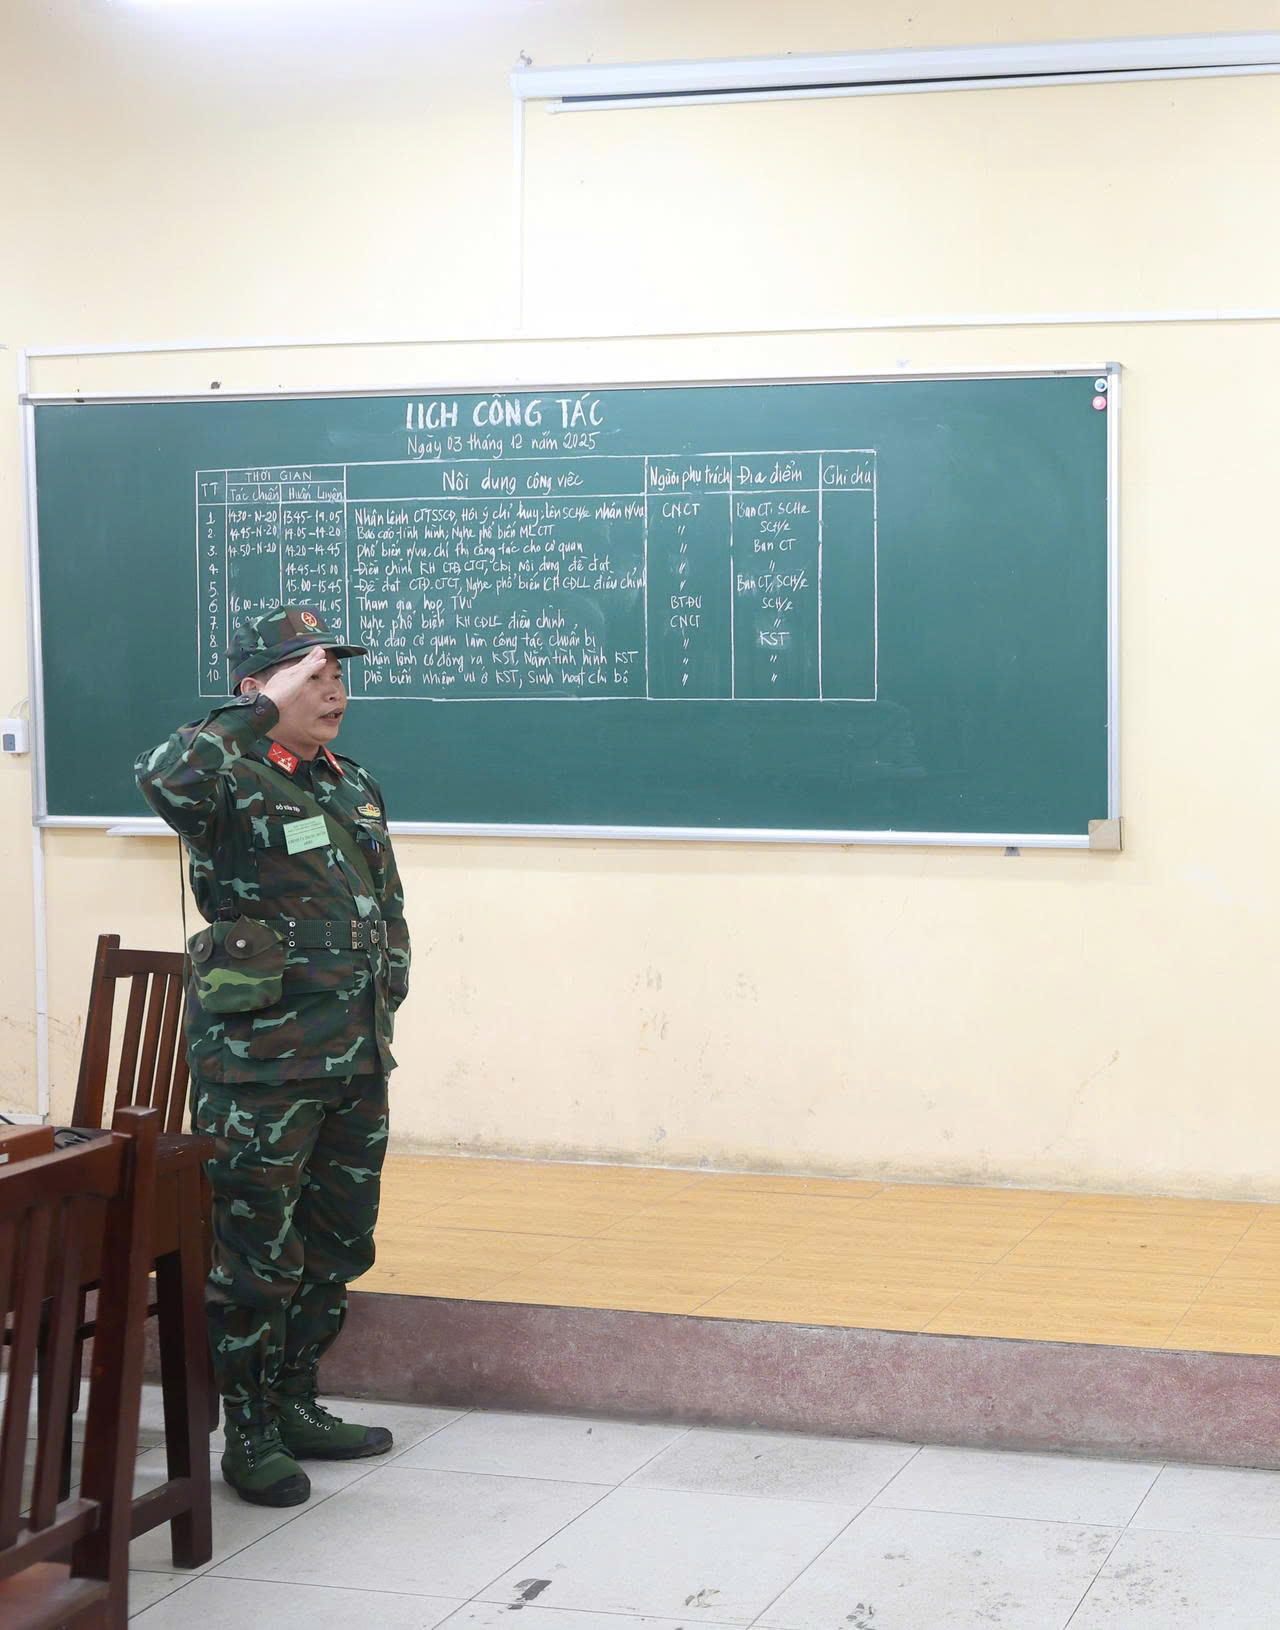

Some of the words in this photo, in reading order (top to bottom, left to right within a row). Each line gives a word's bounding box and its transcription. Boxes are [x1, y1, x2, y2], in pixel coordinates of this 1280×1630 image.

[556, 392, 604, 429] TÁC
[447, 436, 463, 452] 03
[466, 432, 503, 459] tháng
[510, 434, 523, 449] 12
[563, 432, 600, 450] 2025
[280, 470, 312, 481] GIAN
[481, 467, 517, 496] dung
[682, 464, 702, 491] phụ
[705, 464, 731, 484] trách
[770, 460, 803, 485] điểm
[823, 464, 849, 486] Ghi
[851, 460, 872, 485] chú
[201, 482, 218, 497] TT
[230, 487, 249, 502] Tác
[480, 506, 489, 524] ý
[498, 540, 521, 556] tác
[523, 539, 541, 553] cho
[558, 543, 583, 560] quan
[753, 539, 774, 553] Ban
[779, 538, 797, 552] CT
[420, 560, 436, 575] KH
[466, 576, 492, 600] Nghe
[355, 592, 388, 611] Tham
[360, 614, 385, 640] Nghe
[456, 614, 471, 628] KH
[670, 614, 701, 628] CNCT
[430, 634, 457, 656] quan
[493, 631, 518, 652] công
[760, 631, 790, 646] KST
[471, 655, 483, 666] ra
[615, 650, 639, 664] KST
[527, 668, 554, 686] Sinh
